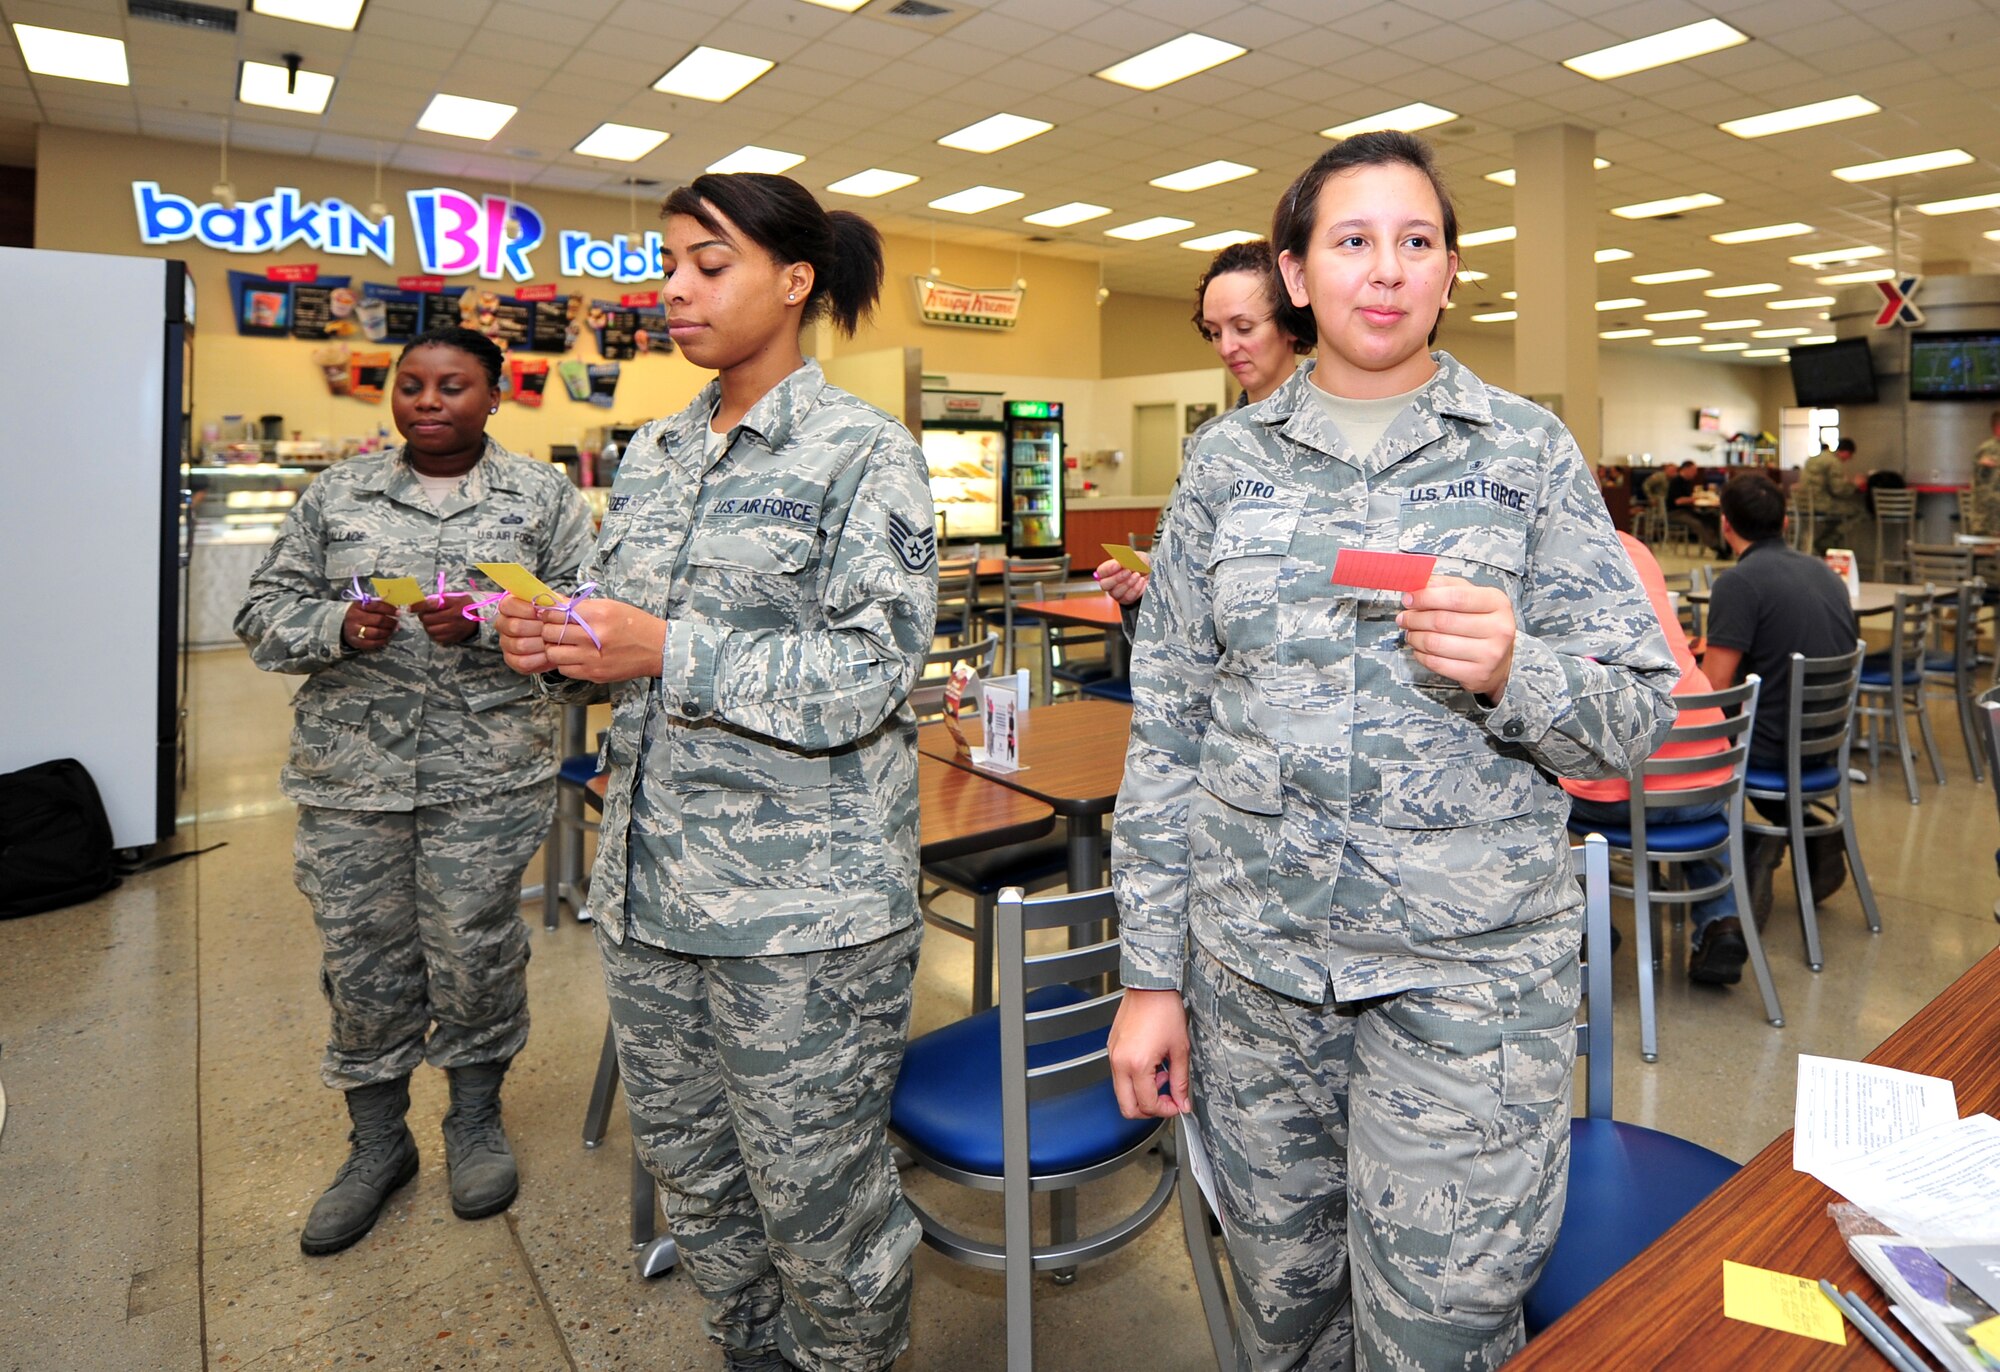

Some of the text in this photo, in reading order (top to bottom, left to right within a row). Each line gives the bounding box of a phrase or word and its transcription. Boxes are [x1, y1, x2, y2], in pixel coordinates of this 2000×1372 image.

[1409, 479, 1530, 512] U.S. AIR FORCE
[713, 498, 814, 522] U.S. AIR FORCE
[496, 530, 512, 542] AIR
